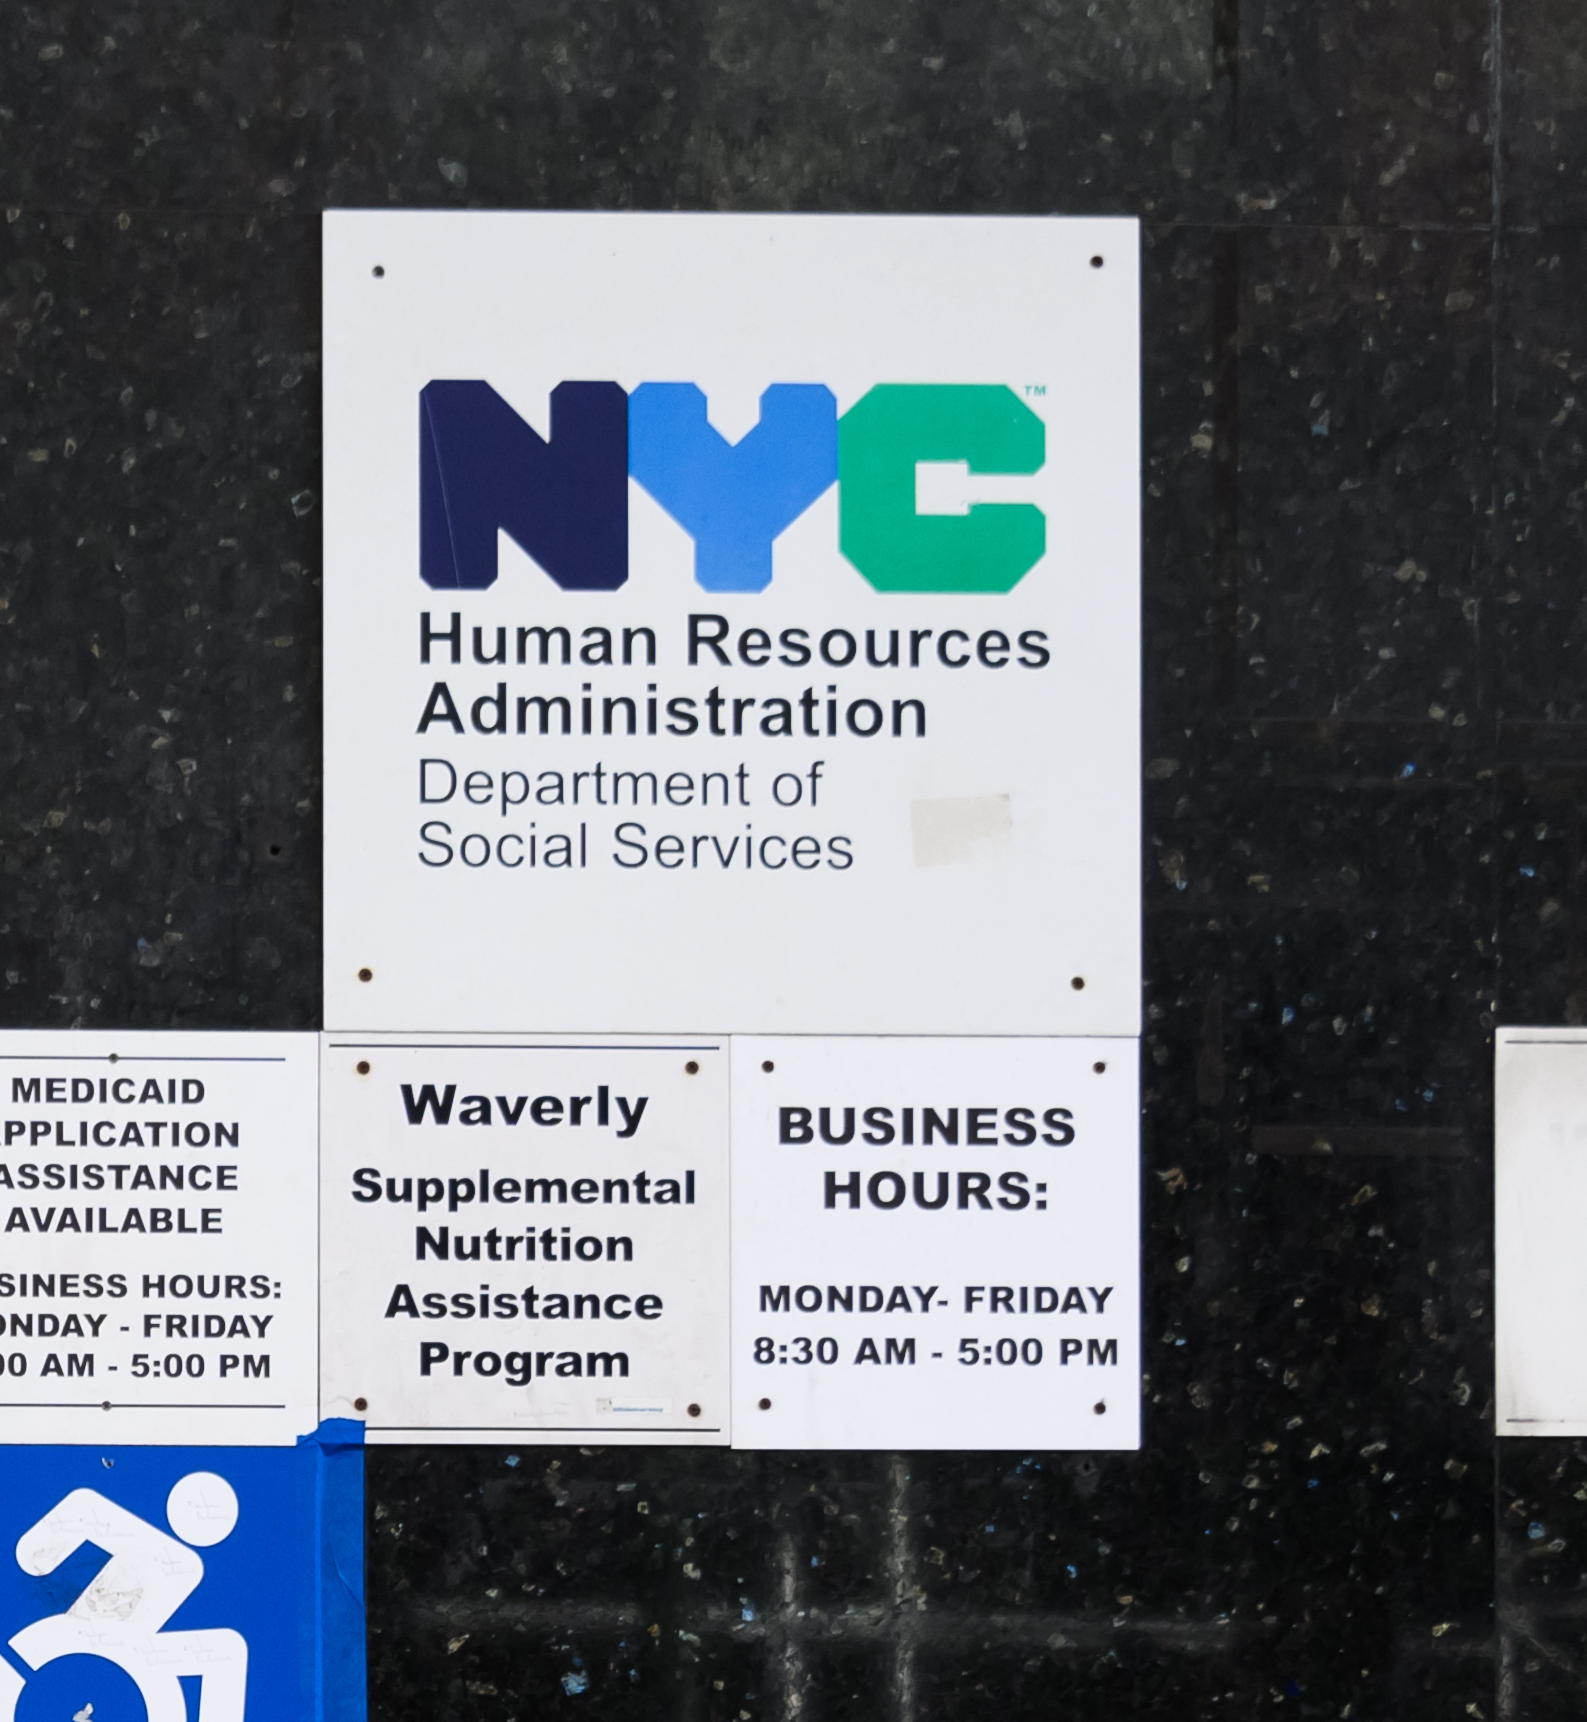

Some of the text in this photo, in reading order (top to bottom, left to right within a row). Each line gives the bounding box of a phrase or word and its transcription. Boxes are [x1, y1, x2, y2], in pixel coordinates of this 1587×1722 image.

[420, 380, 1046, 593] NYC
[421, 612, 1050, 668] Human Resources
[417, 682, 925, 737] Administration
[420, 759, 824, 816] Department of
[419, 821, 853, 869] Social Services
[13, 1078, 204, 1103] MEDICAID
[401, 1084, 648, 1137] Waverly
[780, 1107, 1075, 1146] BUSINESS
[352, 1168, 694, 1211] Supplemental
[825, 1171, 1046, 1210] HOURS:
[5, 1207, 222, 1233] AVAILABLE
[417, 1227, 632, 1261] Nutrition
[143, 1275, 280, 1298] HOURS:
[385, 1284, 662, 1319] Assistance
[965, 1287, 1113, 1313] FRIDAY
[144, 1315, 273, 1338] FRIDAY
[41, 1354, 93, 1376] AM
[132, 1354, 204, 1377] 5:00
[220, 1355, 269, 1377] PM
[421, 1342, 628, 1386] Program
[754, 1337, 838, 1364] 8:30
[855, 1338, 915, 1364] AM
[959, 1338, 1042, 1365] 5:00
[1061, 1339, 1117, 1365] PM
